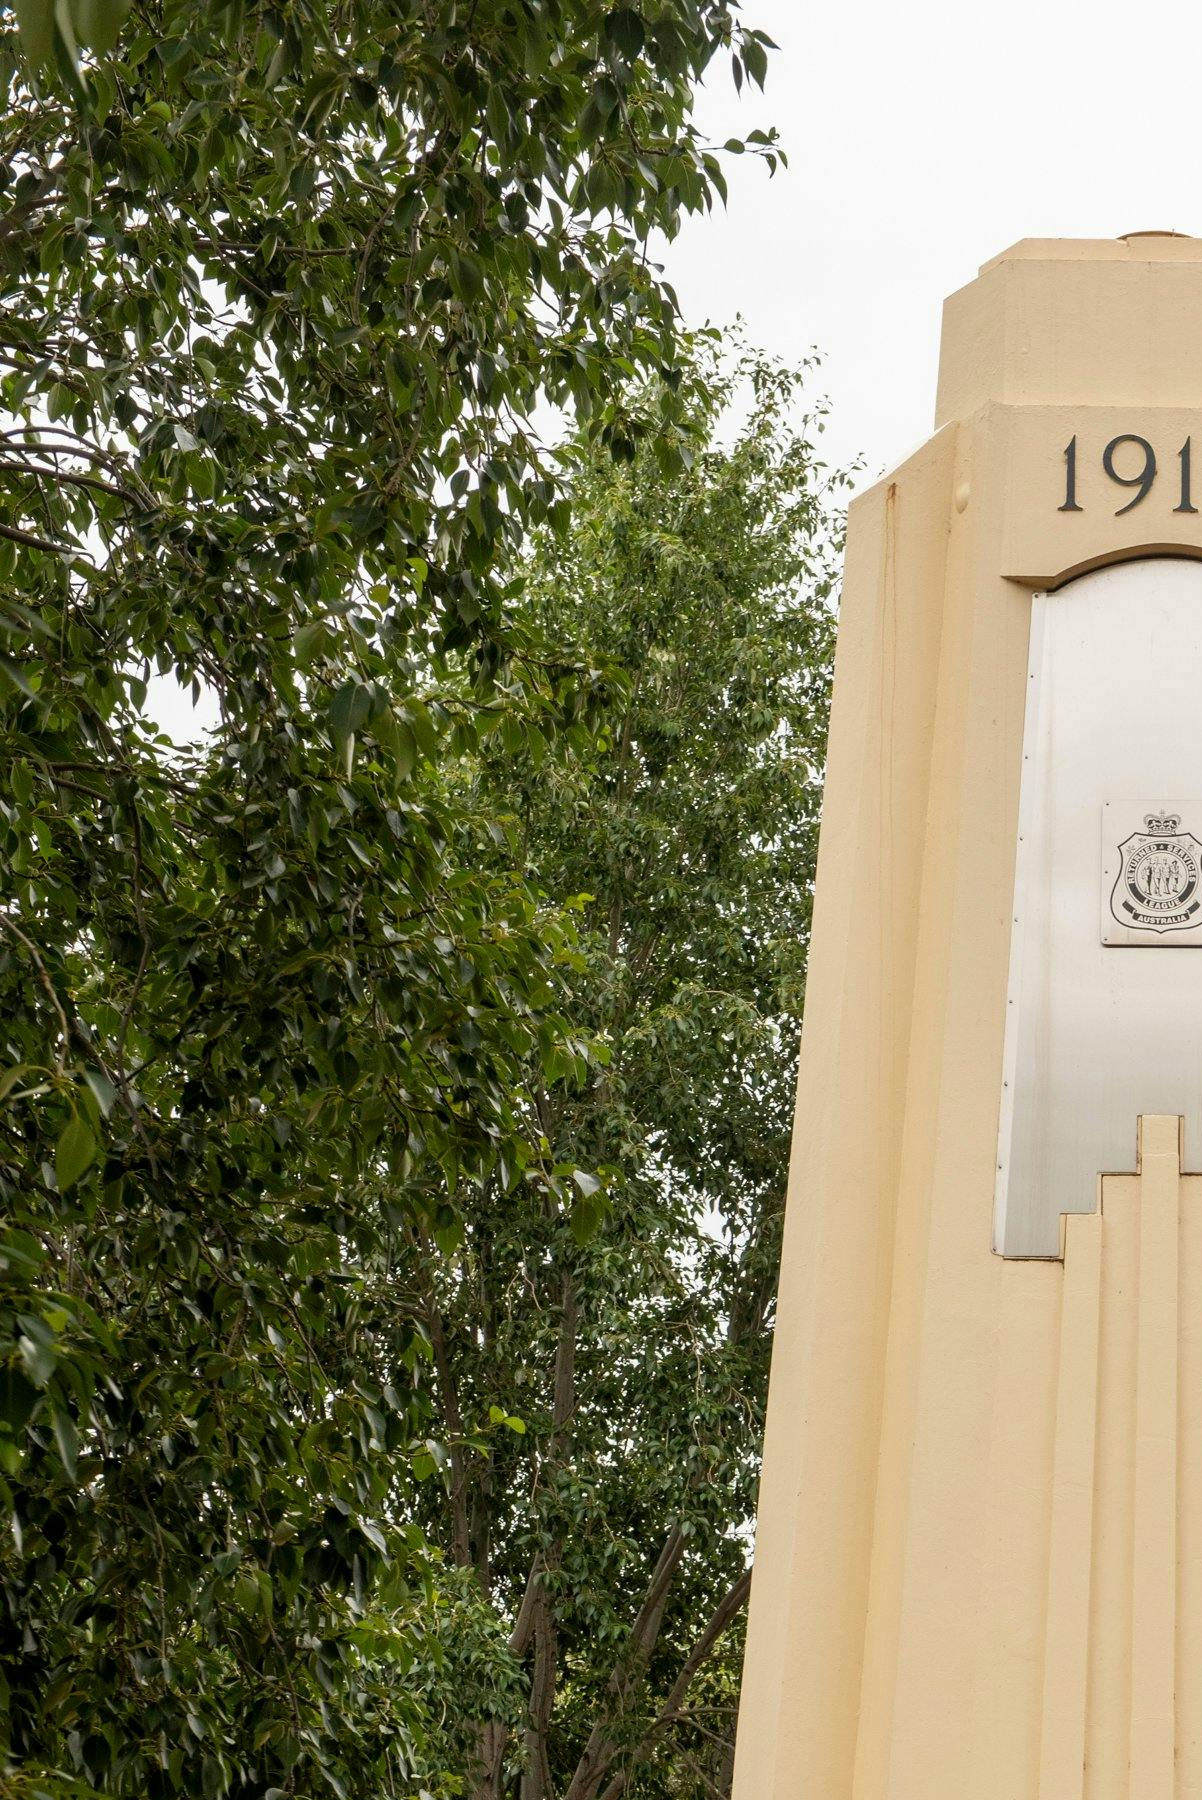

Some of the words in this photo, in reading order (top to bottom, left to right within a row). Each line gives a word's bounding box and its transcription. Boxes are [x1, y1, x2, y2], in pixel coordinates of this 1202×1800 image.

[1128, 844, 1157, 884] RETURNED
[1167, 844, 1196, 882] SERVICES
[1143, 898, 1181, 910] LEAGUE
[1138, 915, 1187, 924] AUSTRALIA
